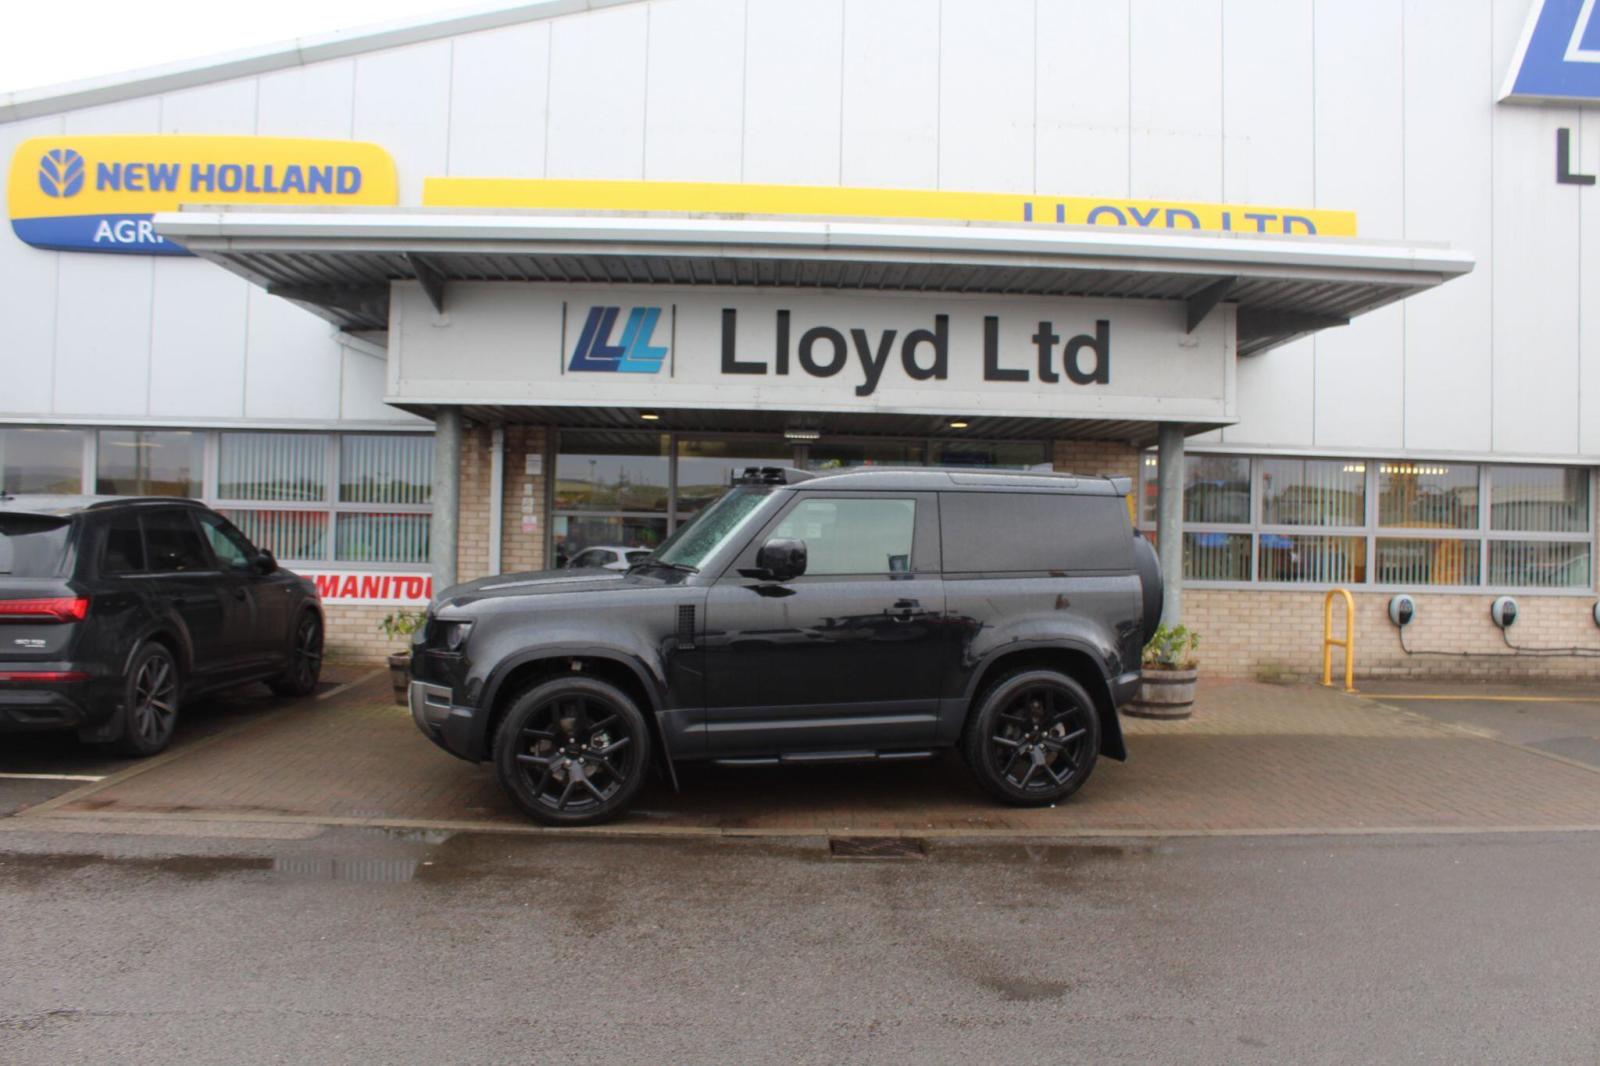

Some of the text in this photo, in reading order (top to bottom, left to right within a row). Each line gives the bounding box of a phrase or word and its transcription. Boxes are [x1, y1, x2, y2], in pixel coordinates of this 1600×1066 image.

[96, 162, 361, 194] NEW HOLLAND
[721, 308, 1110, 396] Lloyd Ltd
